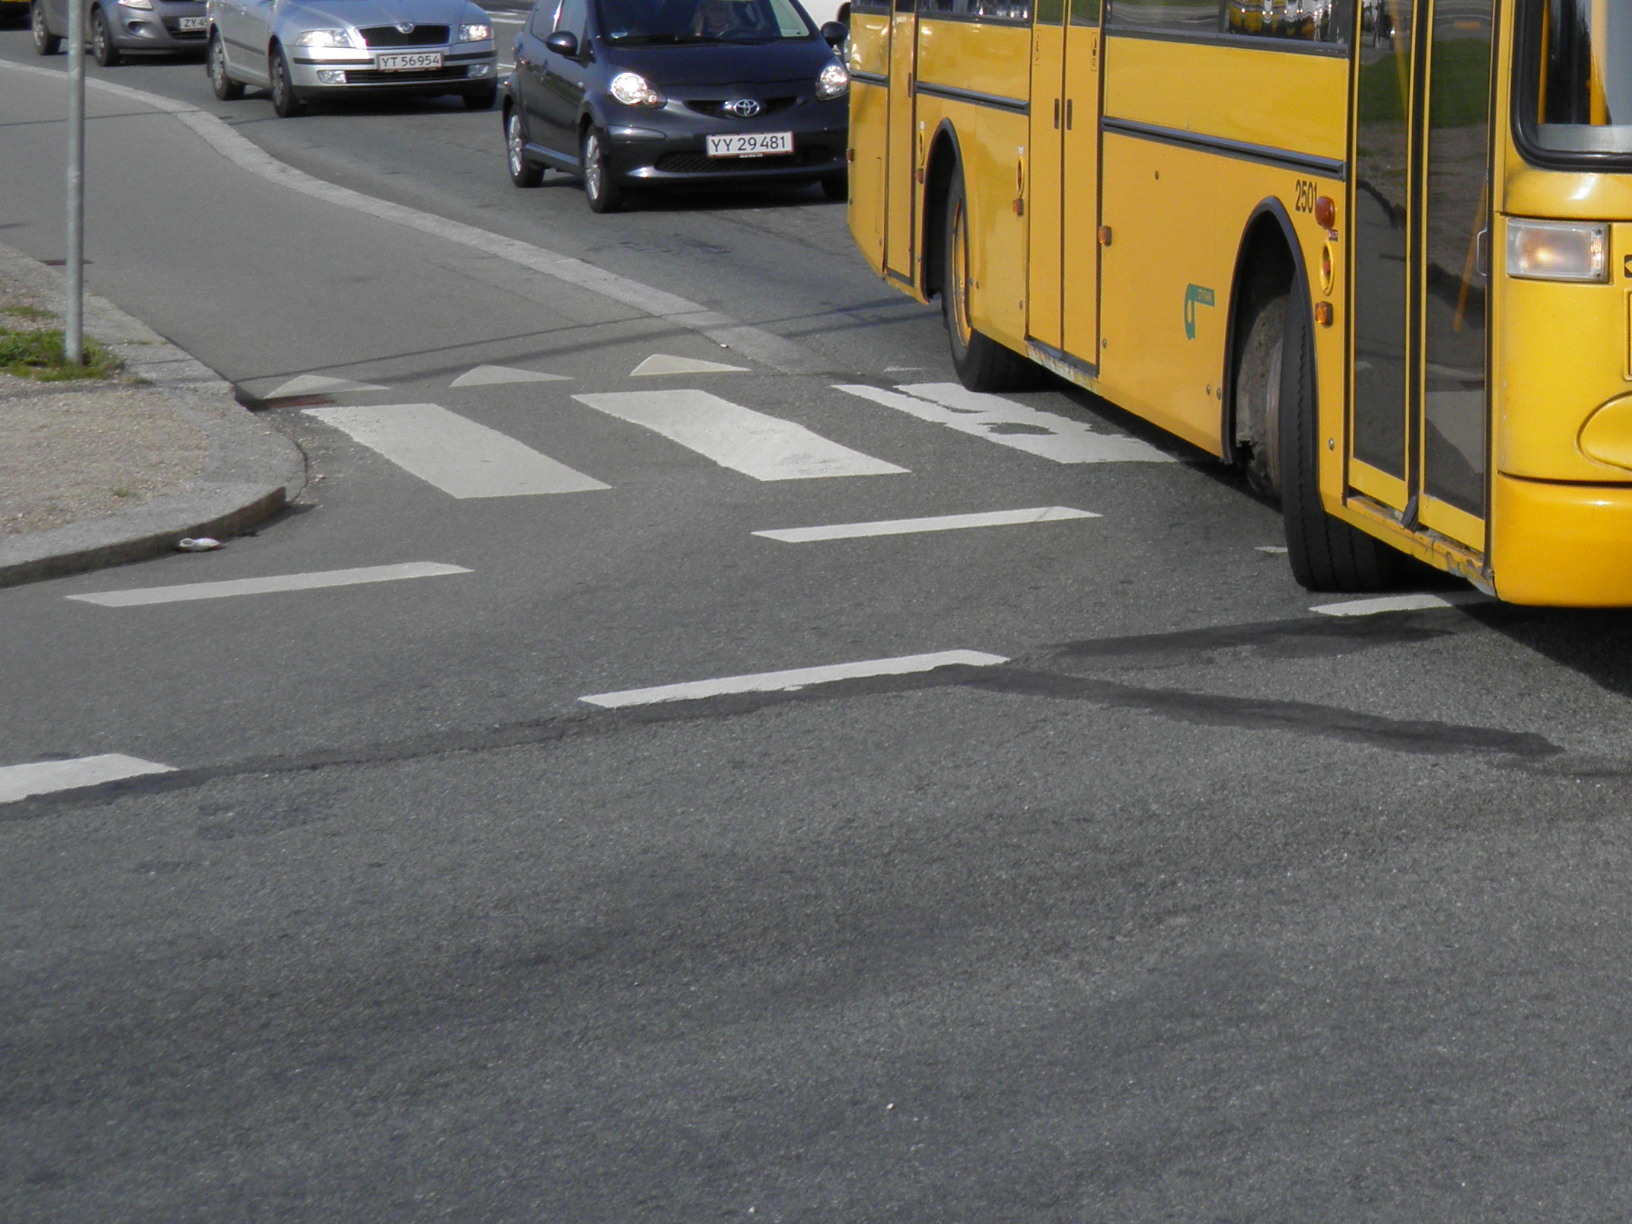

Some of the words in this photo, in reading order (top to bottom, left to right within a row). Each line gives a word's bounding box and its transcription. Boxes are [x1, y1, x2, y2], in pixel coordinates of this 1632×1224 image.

[184, 18, 196, 27] ZY
[381, 56, 398, 67] YT
[711, 138, 733, 152] YY
[1295, 179, 1317, 214] 2501
